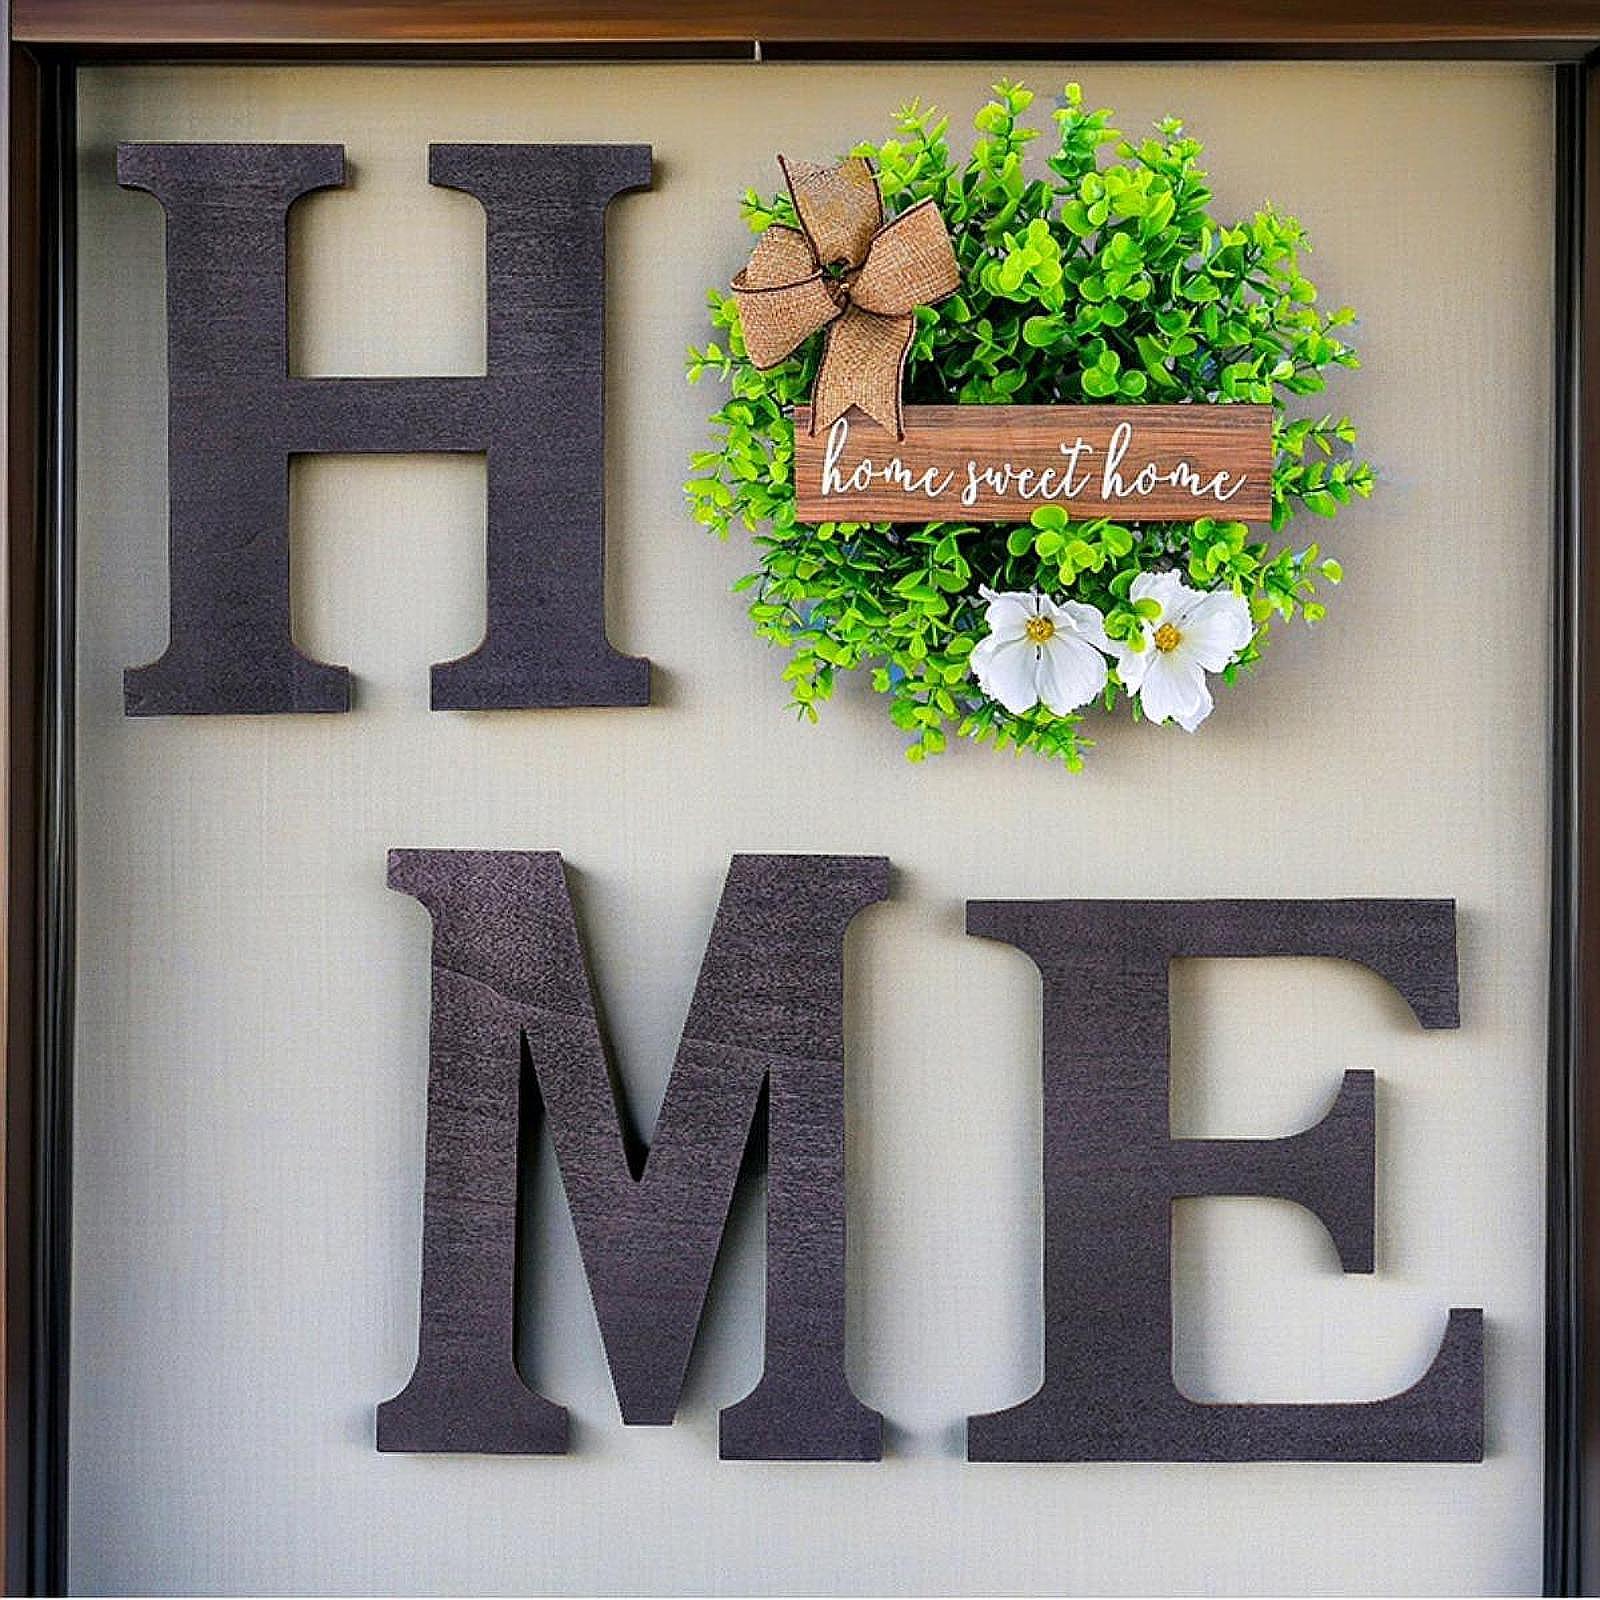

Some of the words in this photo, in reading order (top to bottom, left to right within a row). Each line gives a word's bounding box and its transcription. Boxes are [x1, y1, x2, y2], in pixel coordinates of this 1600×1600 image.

[820, 416, 955, 498] home
[960, 436, 1093, 507] sweet
[1101, 421, 1248, 502] home
